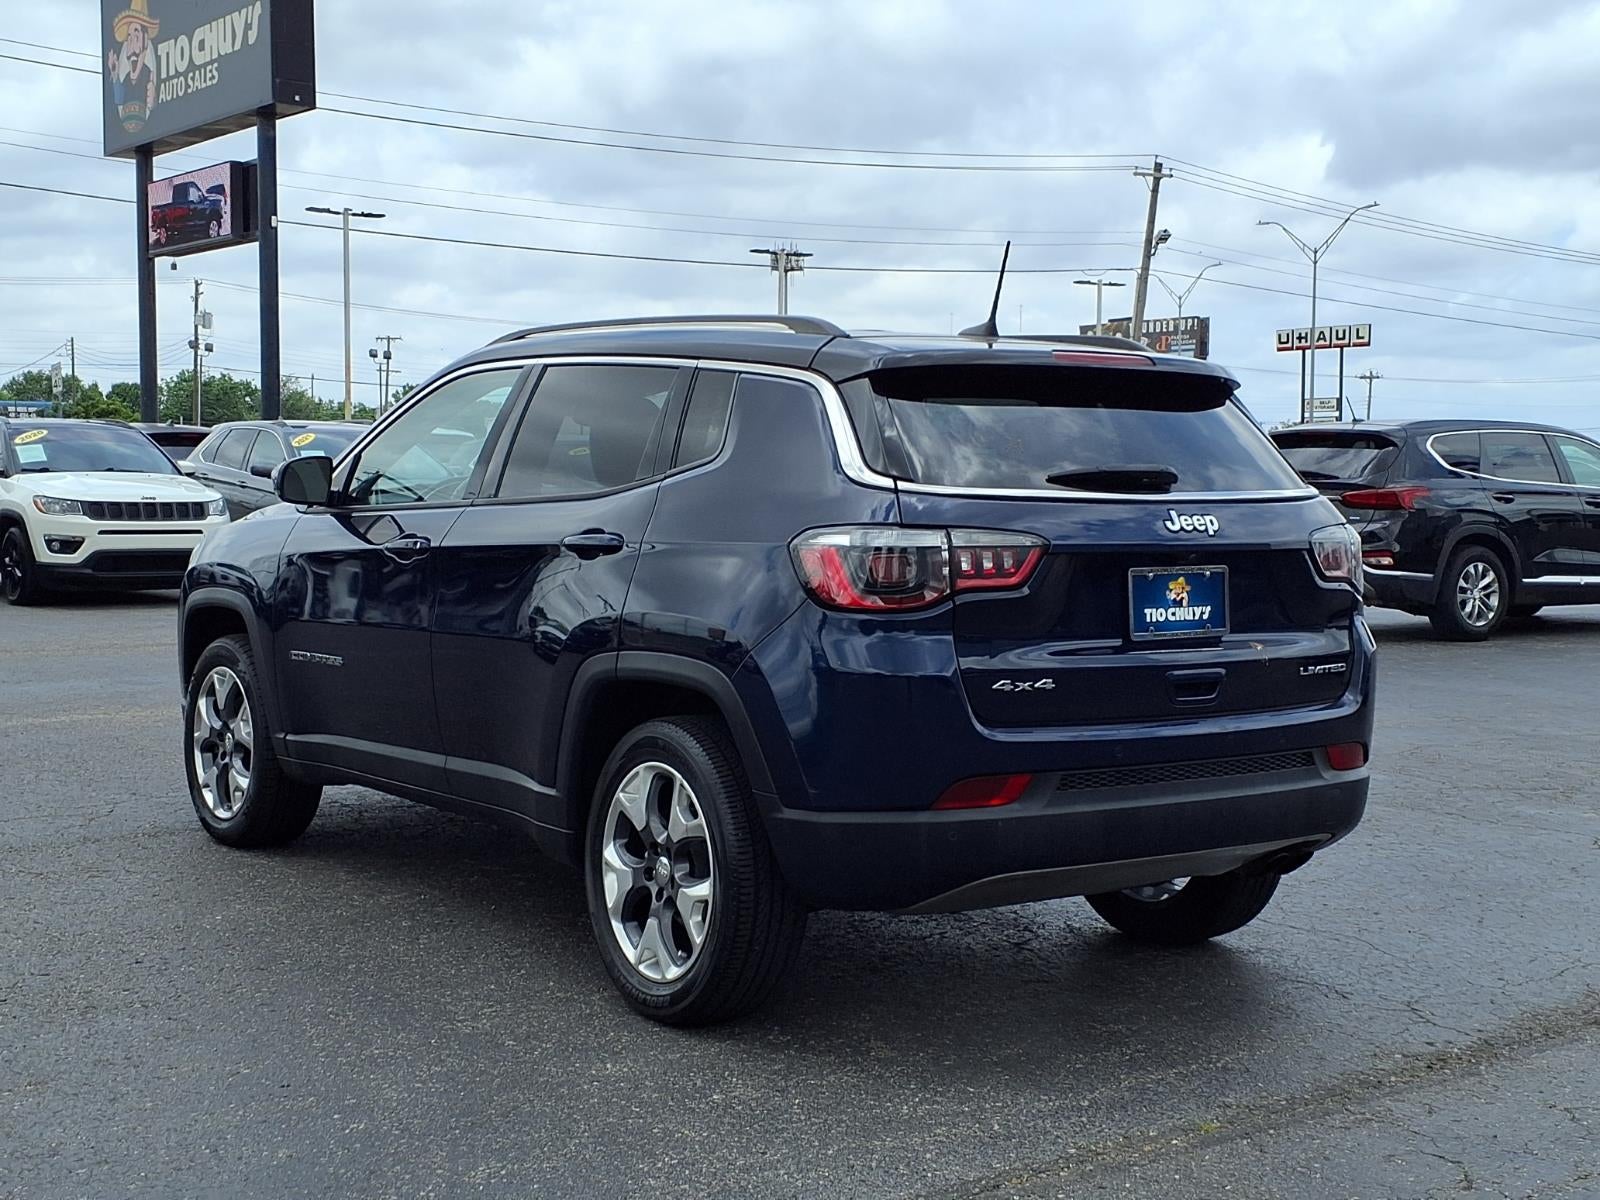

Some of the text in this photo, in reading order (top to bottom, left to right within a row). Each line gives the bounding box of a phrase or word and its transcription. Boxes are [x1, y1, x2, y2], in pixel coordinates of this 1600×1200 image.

[157, 1, 262, 79] TIO CHUY'S
[159, 62, 219, 104] AUTO SALES
[1129, 319, 1174, 337] TUNDER
[1163, 509, 1220, 536] Jeep
[1144, 605, 1211, 622] TIO CHUY'S
[991, 679, 1056, 692] 4x4
